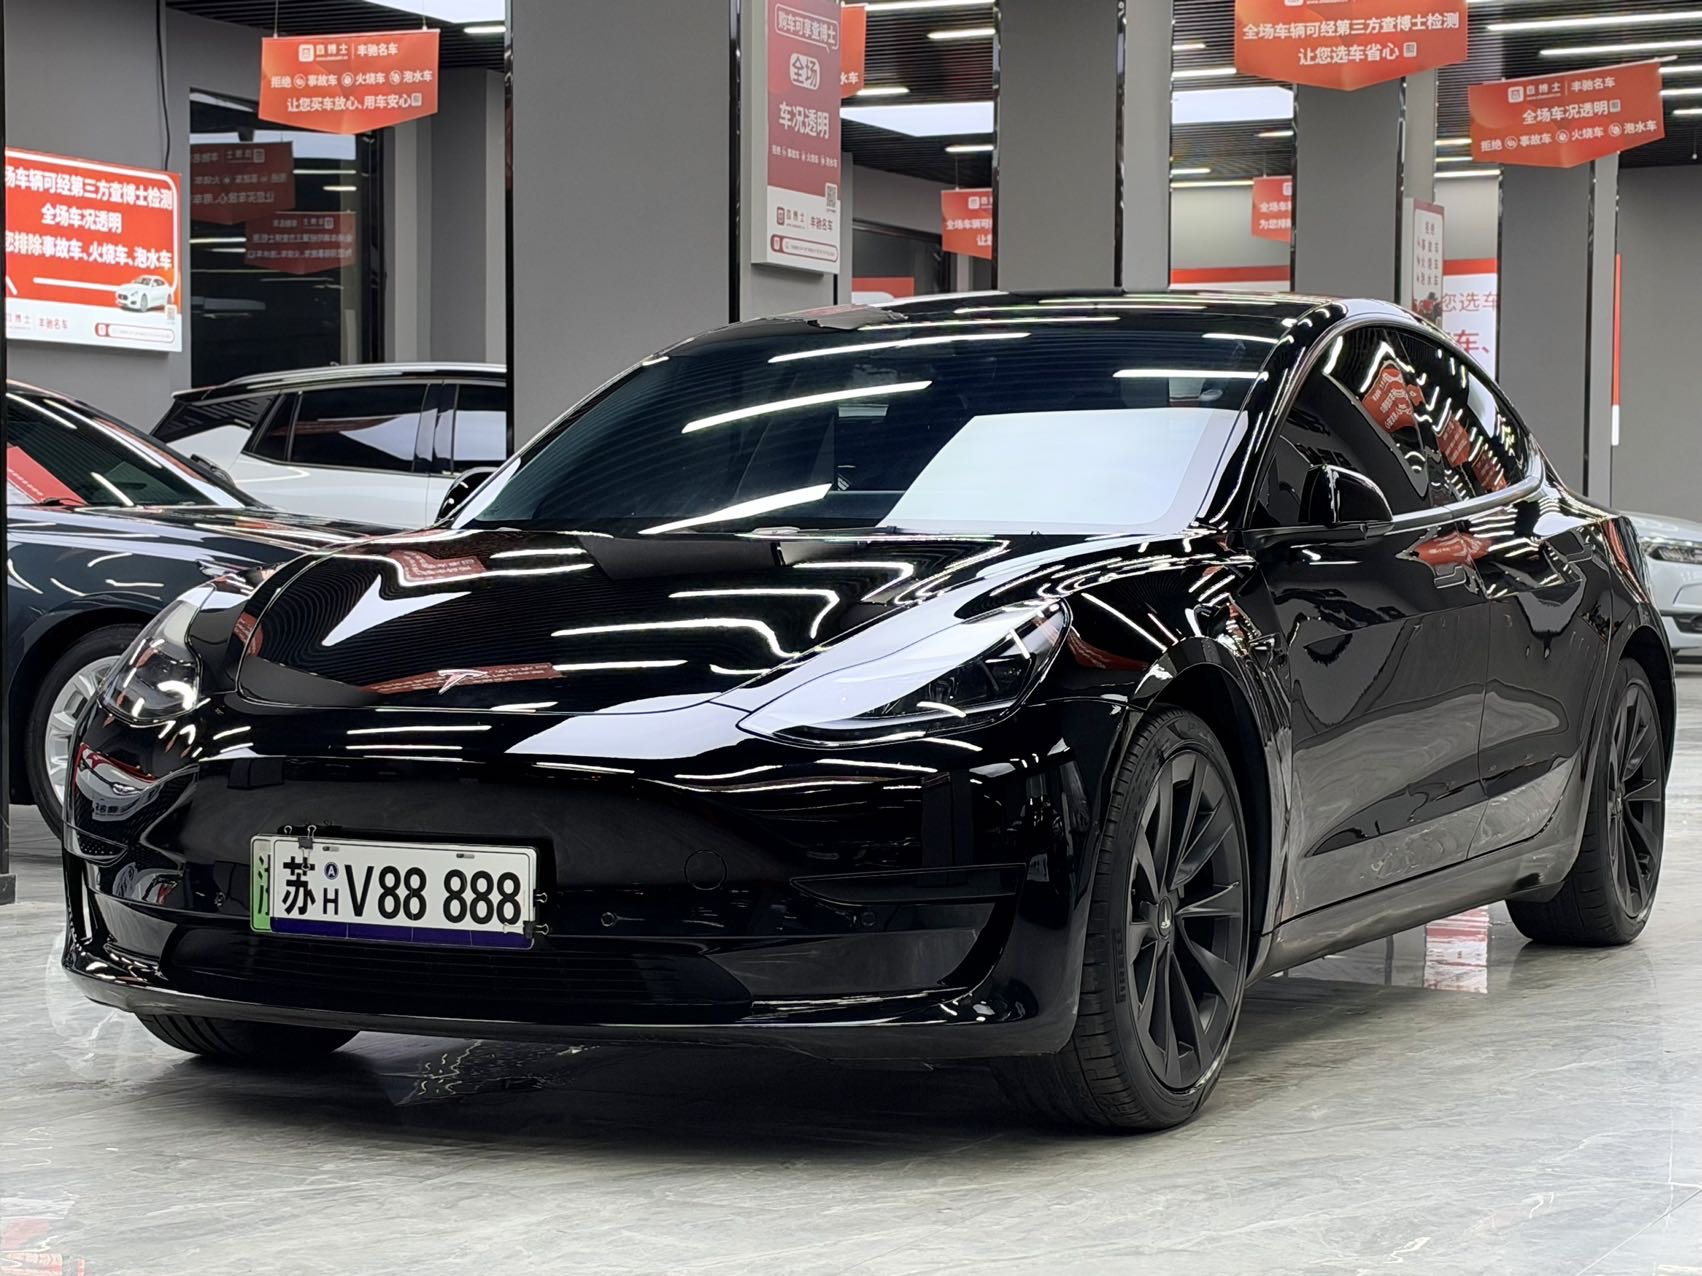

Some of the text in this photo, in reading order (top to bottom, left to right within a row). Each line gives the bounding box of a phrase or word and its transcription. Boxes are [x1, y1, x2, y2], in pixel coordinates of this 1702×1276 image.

[778, 11, 837, 45] 购车可享查博士
[1242, 12, 1460, 40] 全场车辆可经第三方查博士检测
[1299, 44, 1400, 66] 让您选车省心
[271, 70, 433, 88] 拒绝 事故车 火烧车 泡水车
[792, 56, 818, 89] 全场
[287, 94, 410, 113] 让您买车放心、用车安心
[779, 101, 830, 139] 车况透明
[1522, 101, 1609, 125] 全场车况透明
[1480, 119, 1657, 152] 拒绝 事故车 火烧车 泡水车
[5, 165, 173, 211] 场车辆可经第三方查博士检测
[41, 201, 123, 234] 全场车况透明
[282, 855, 316, 916] 苏
